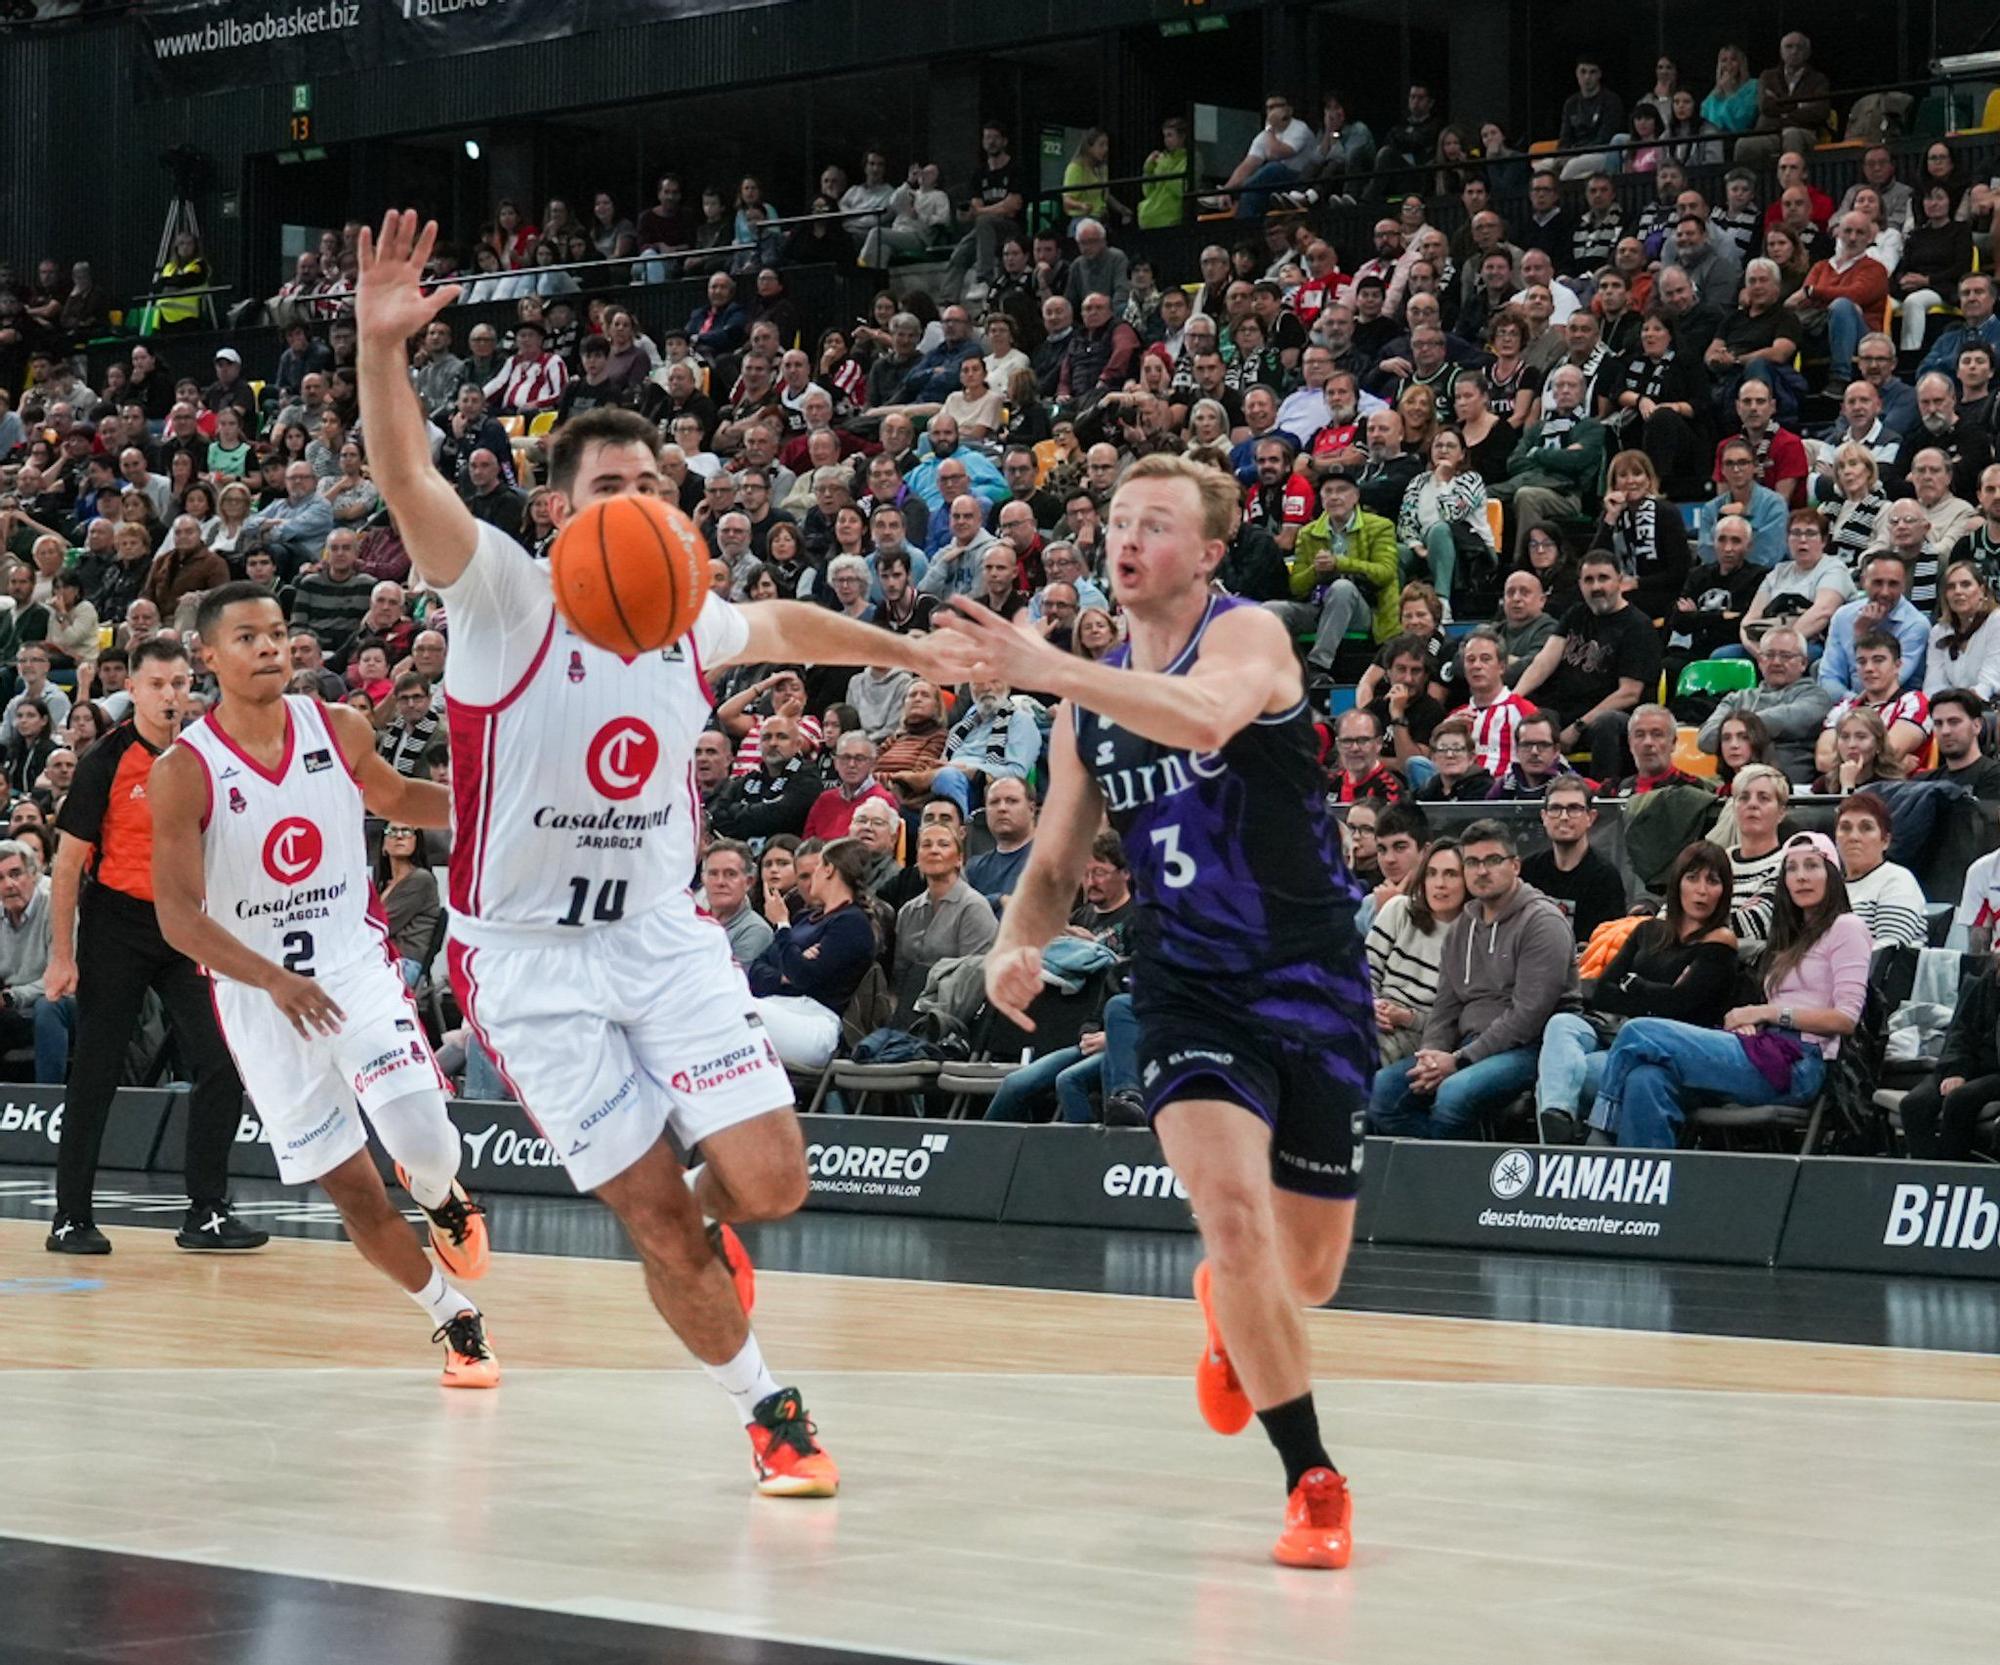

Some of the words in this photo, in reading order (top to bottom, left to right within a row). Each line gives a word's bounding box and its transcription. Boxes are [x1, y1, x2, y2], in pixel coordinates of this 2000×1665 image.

[154, 1, 360, 58] www.bilbaobasket.biz
[291, 116, 309, 140] 13
[1635, 494, 1657, 560] SKET
[1150, 823, 1197, 888] 3
[556, 876, 629, 928] 14
[282, 930, 316, 977] 2
[692, 1045, 756, 1077] Zaragoza
[0, 1102, 48, 1131] bk
[806, 1144, 930, 1180] CORREO
[1280, 1150, 1347, 1176] NISSAN
[1535, 1154, 1671, 1205] YAMAHA
[862, 1182, 885, 1195] CON
[887, 1183, 921, 1197] VALOR
[1478, 1207, 1660, 1236] deustomotocenter.com
[1883, 1183, 2000, 1250] Bilb
